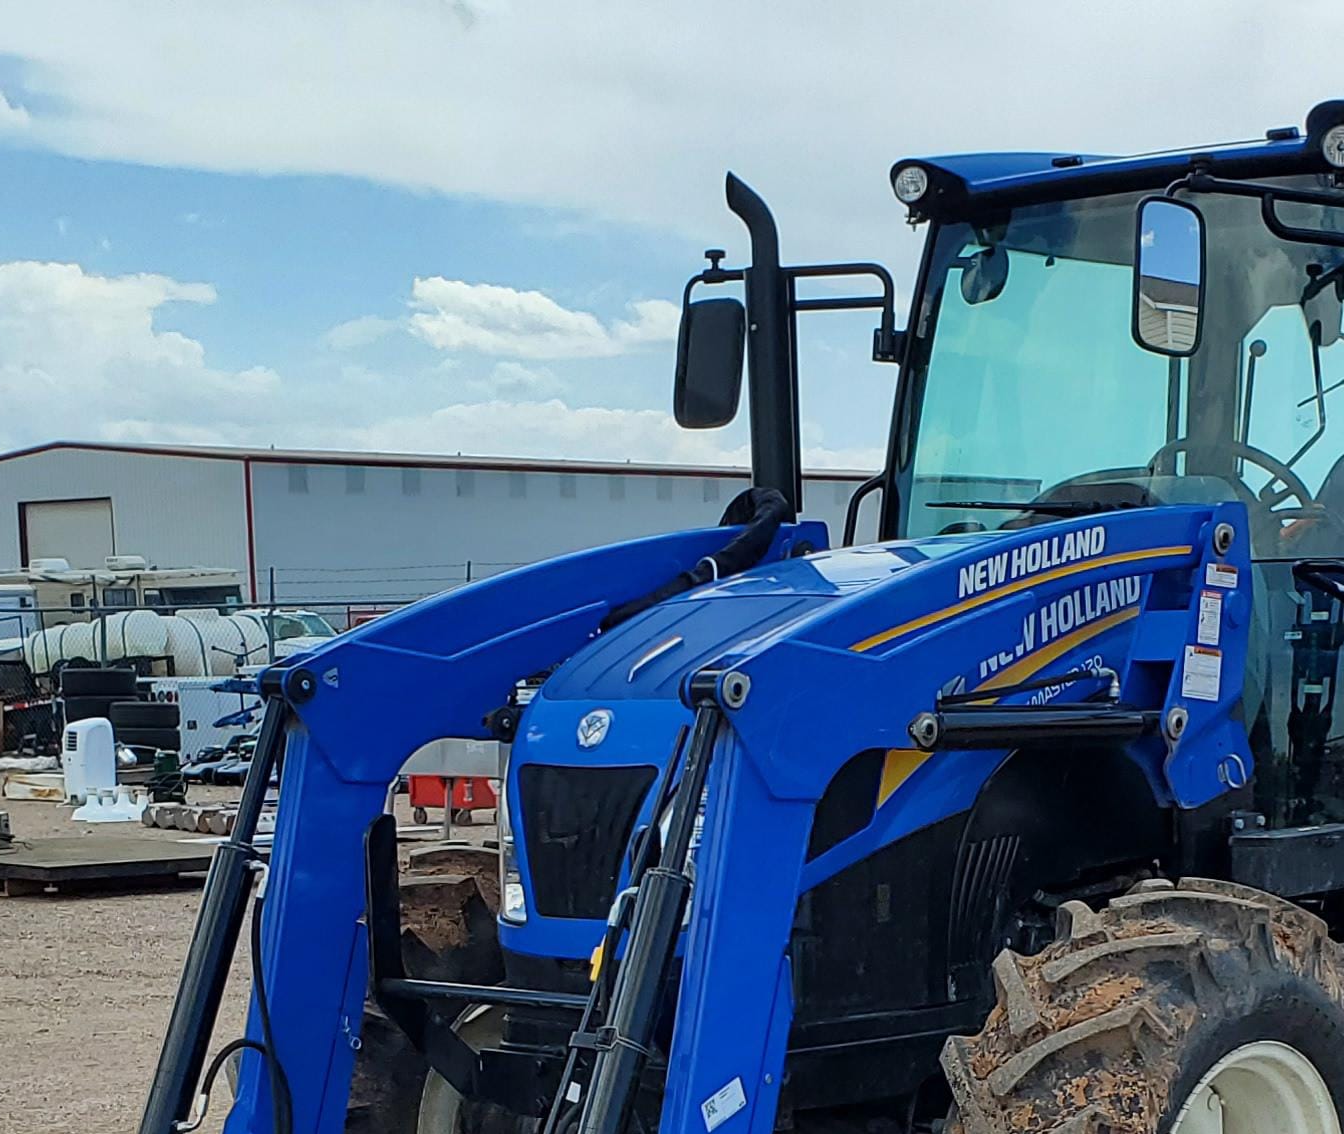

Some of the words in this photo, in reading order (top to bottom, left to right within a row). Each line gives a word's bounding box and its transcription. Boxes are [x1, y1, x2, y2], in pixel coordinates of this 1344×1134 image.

[958, 553, 1007, 599] NEW
[1011, 526, 1106, 578] HOLLAND
[1041, 575, 1140, 642] HOLLAND
